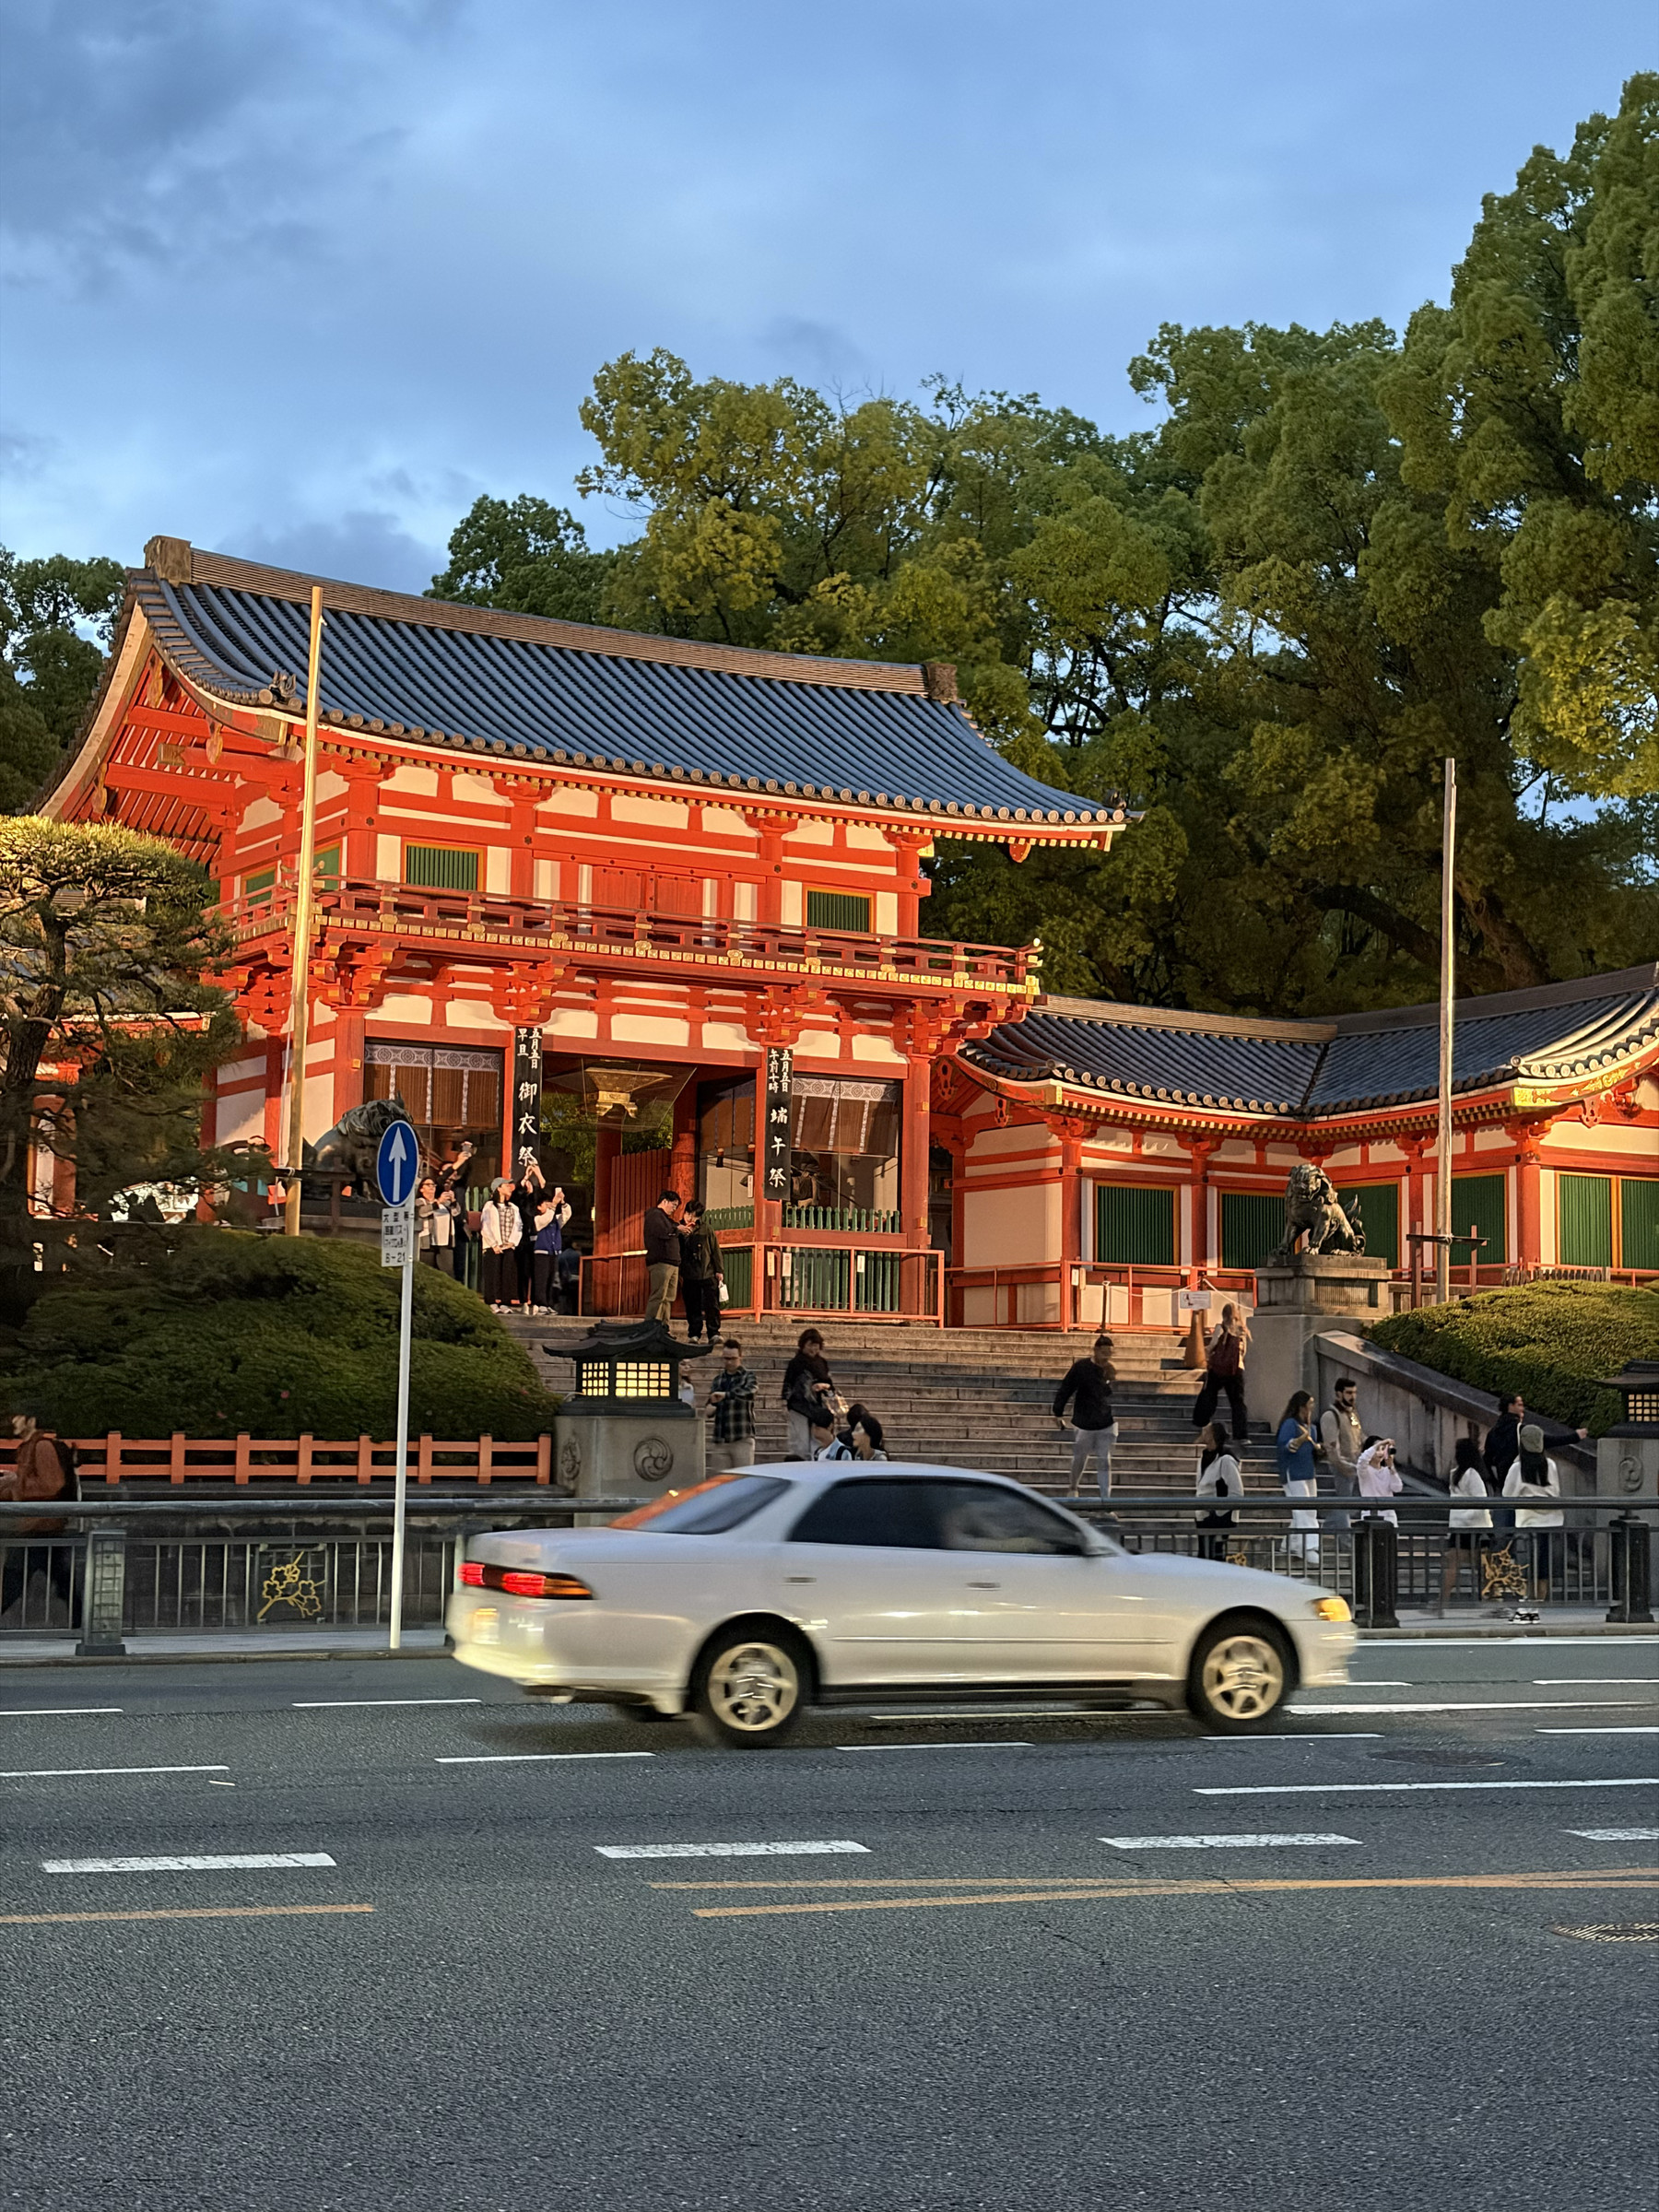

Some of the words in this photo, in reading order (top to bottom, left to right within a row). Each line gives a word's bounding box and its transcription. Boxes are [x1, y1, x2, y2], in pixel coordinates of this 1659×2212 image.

[517, 1028, 529, 1056] 早旦
[528, 1028, 542, 1069] 五月五日
[769, 1049, 780, 1093] 午前十時
[780, 1050, 792, 1093] 五月五日
[518, 1081, 538, 1167] 御衣祭
[769, 1107, 787, 1188] 端午祭
